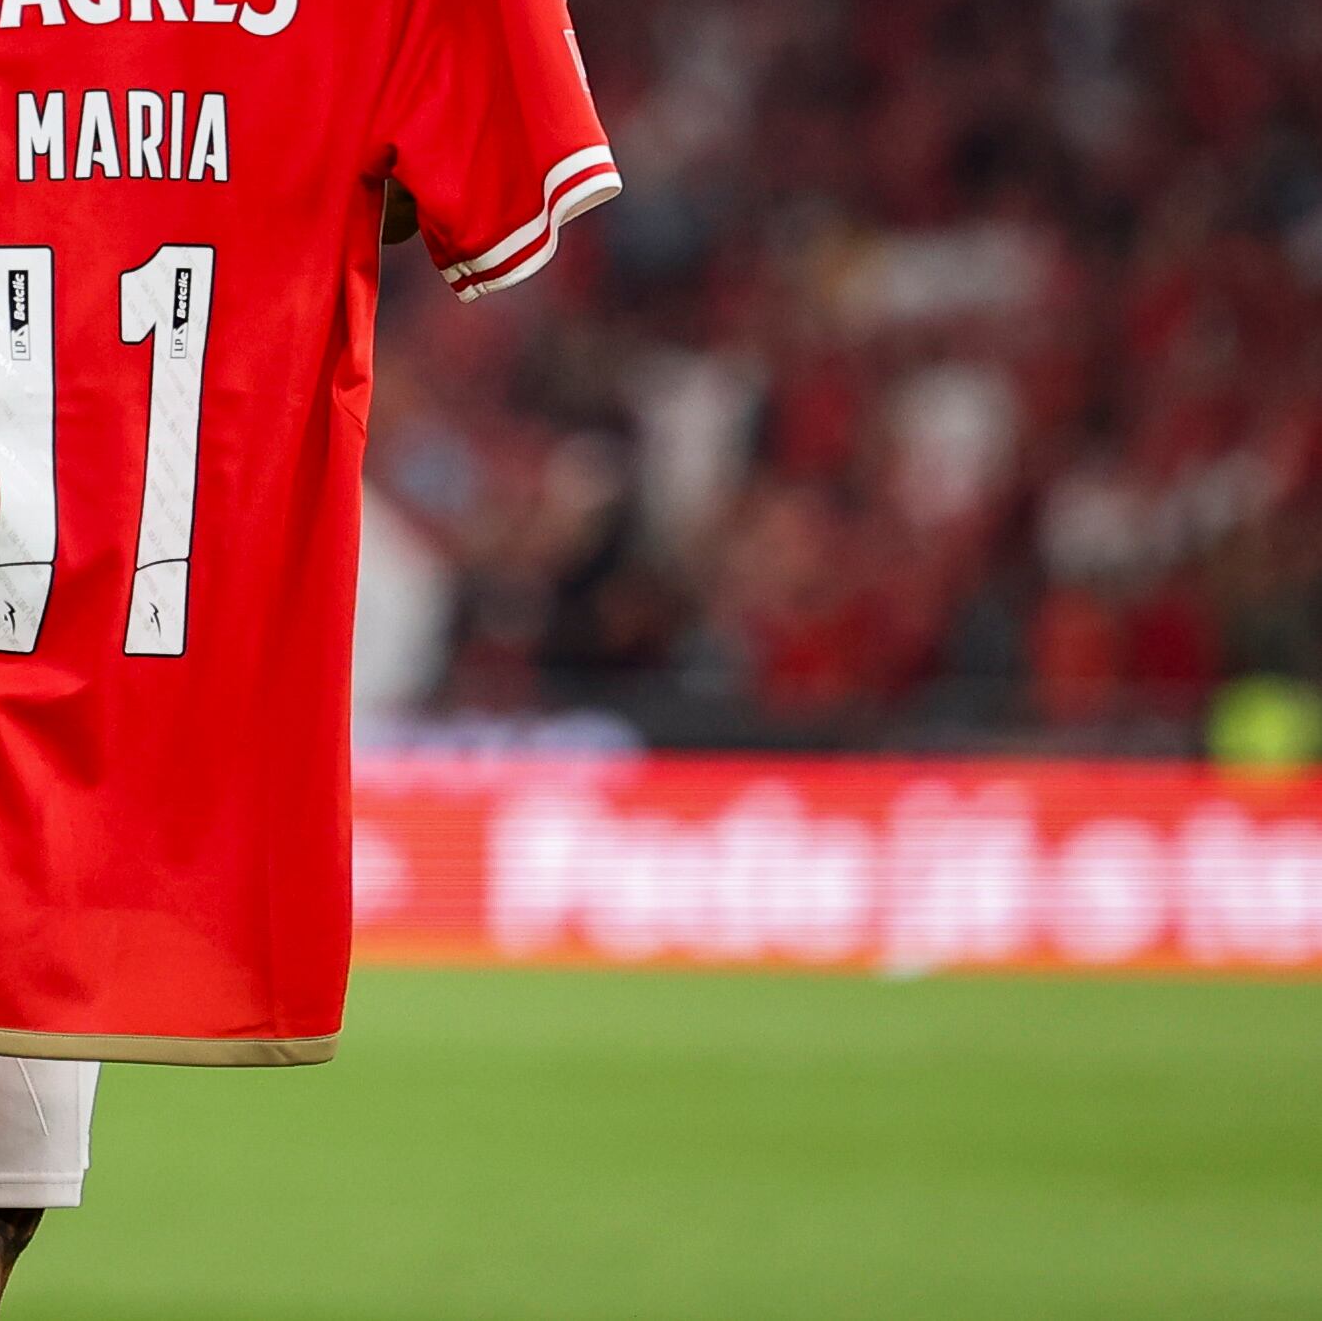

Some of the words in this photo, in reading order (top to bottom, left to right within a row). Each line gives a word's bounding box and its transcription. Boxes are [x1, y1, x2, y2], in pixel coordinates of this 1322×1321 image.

[15, 88, 230, 183] MARIA
[13, 271, 26, 322] Betclic
[176, 270, 189, 320] Betclic
